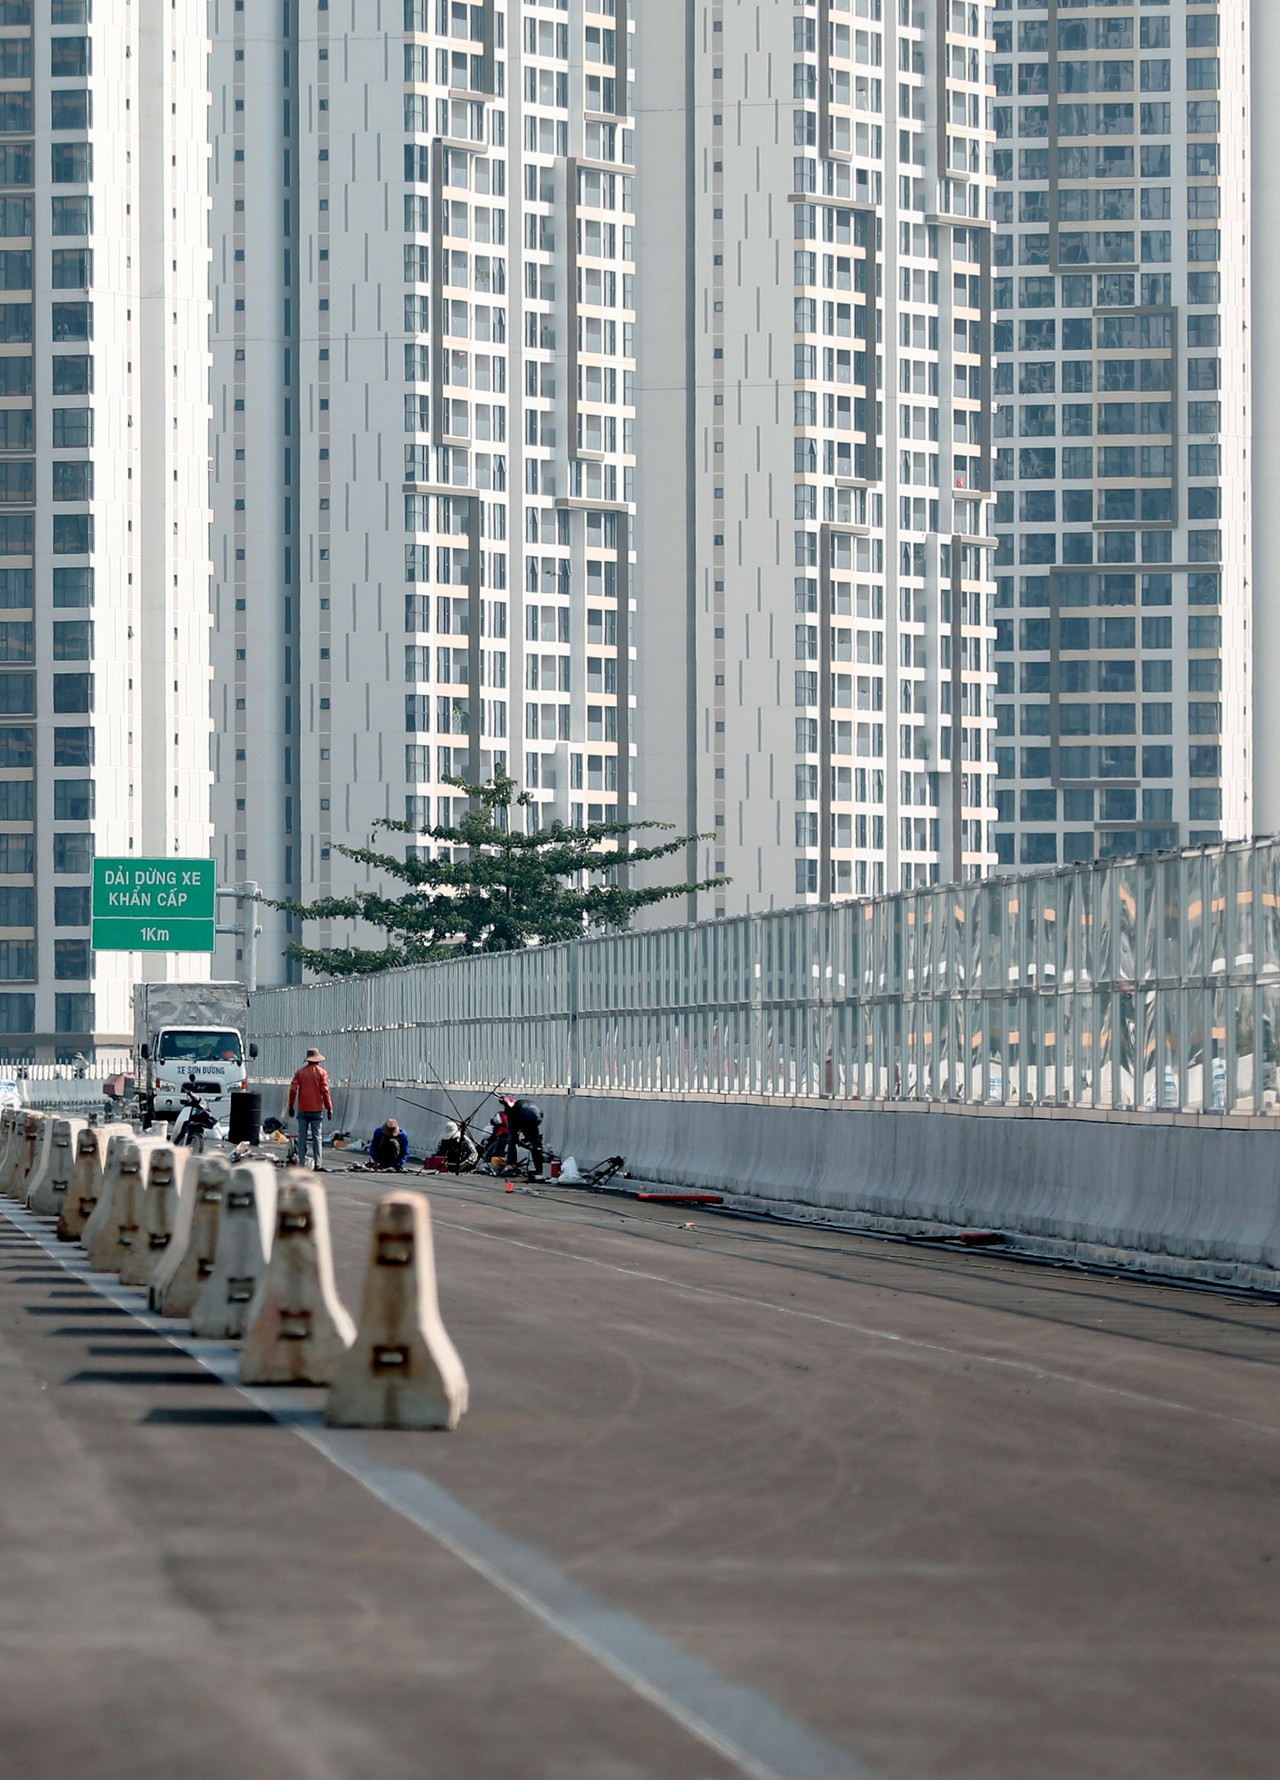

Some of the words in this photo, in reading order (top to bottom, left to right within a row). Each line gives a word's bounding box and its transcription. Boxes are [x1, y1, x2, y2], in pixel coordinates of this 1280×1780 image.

[105, 865, 129, 885] DẢI
[135, 867, 177, 885] DỪNG
[181, 872, 201, 885] XE
[108, 885, 151, 906] KHẨN
[157, 888, 188, 907] CẤP
[140, 927, 170, 941] 1Km
[176, 1066, 186, 1075] XE
